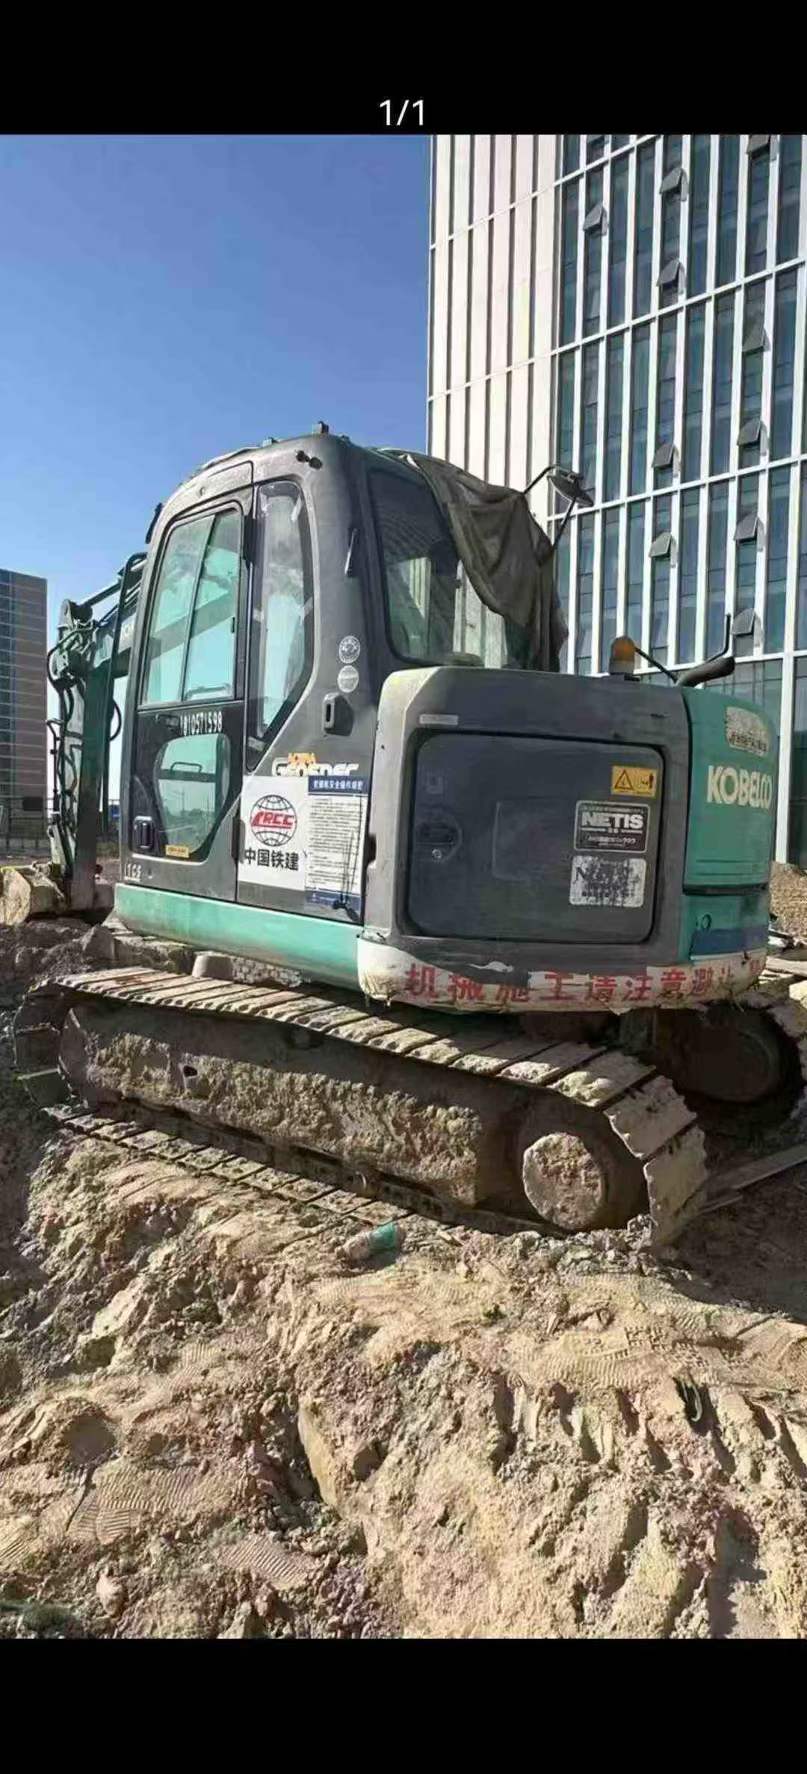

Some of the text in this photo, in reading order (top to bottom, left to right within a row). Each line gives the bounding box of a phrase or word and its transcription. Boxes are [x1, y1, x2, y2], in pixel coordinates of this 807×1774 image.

[581, 812, 644, 829] NETIS
[244, 848, 299, 871] 中国铁建
